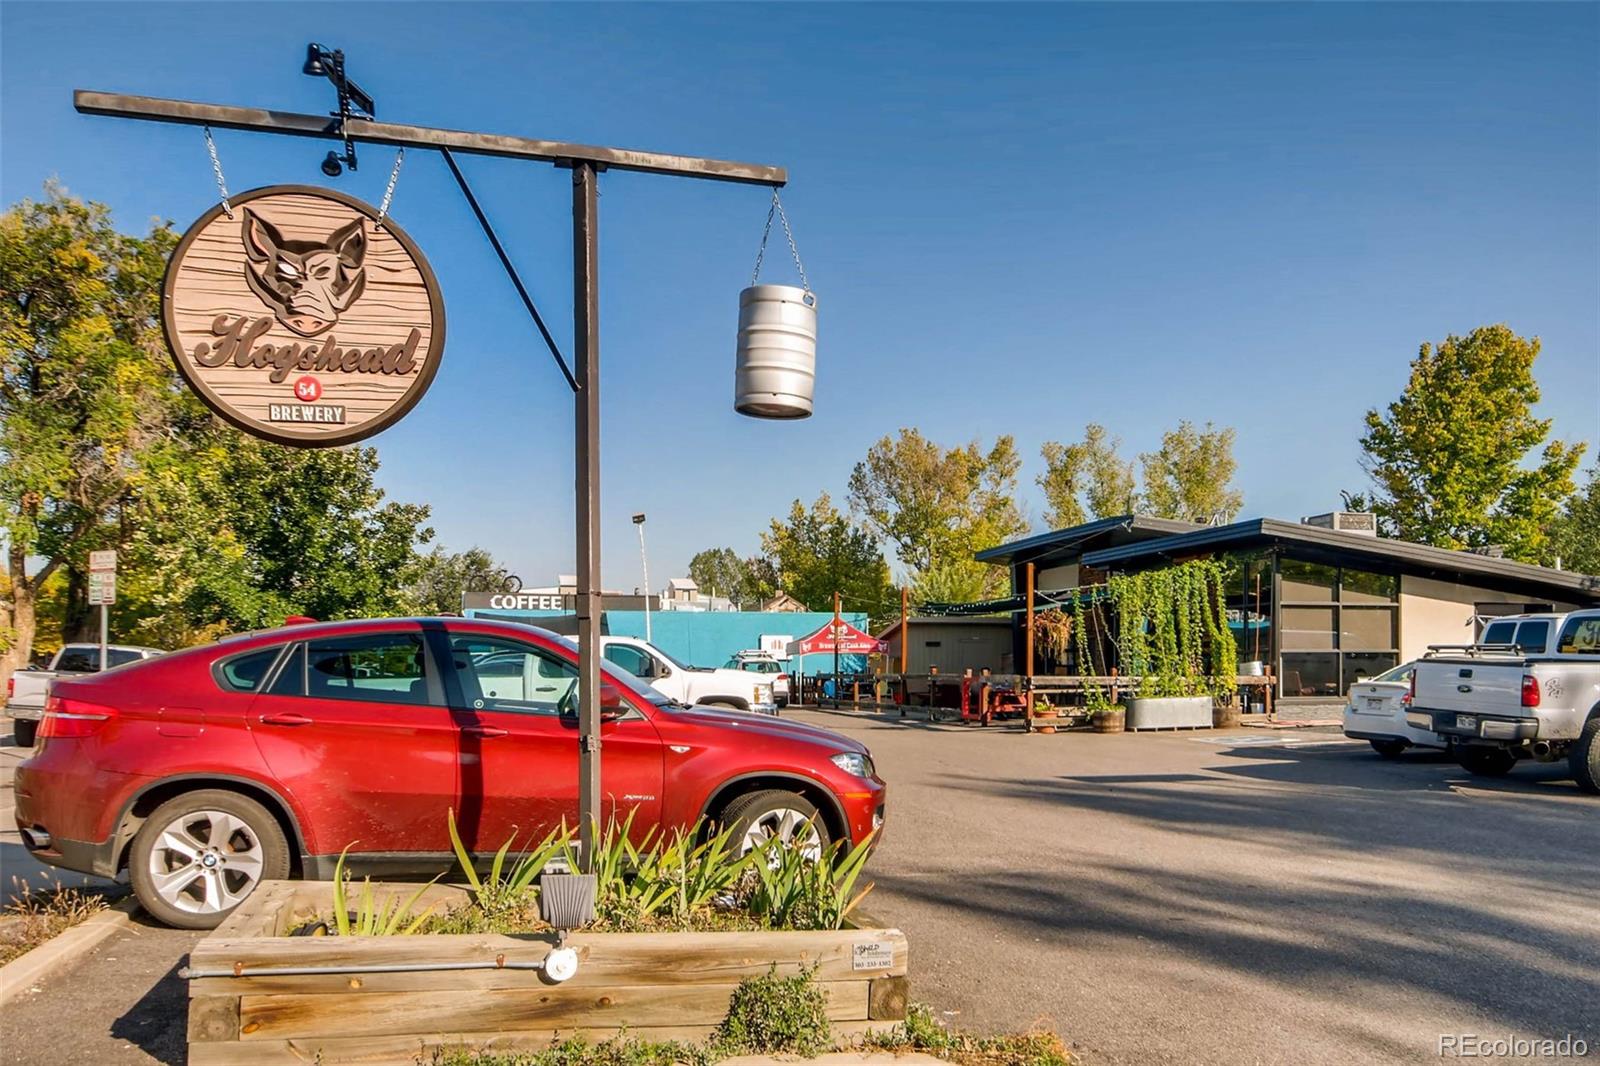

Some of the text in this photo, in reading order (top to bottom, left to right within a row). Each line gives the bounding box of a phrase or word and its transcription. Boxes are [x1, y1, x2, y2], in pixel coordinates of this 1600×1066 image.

[299, 383, 316, 396] 54
[270, 404, 342, 422] BREWERY
[490, 594, 562, 610] COFFEE
